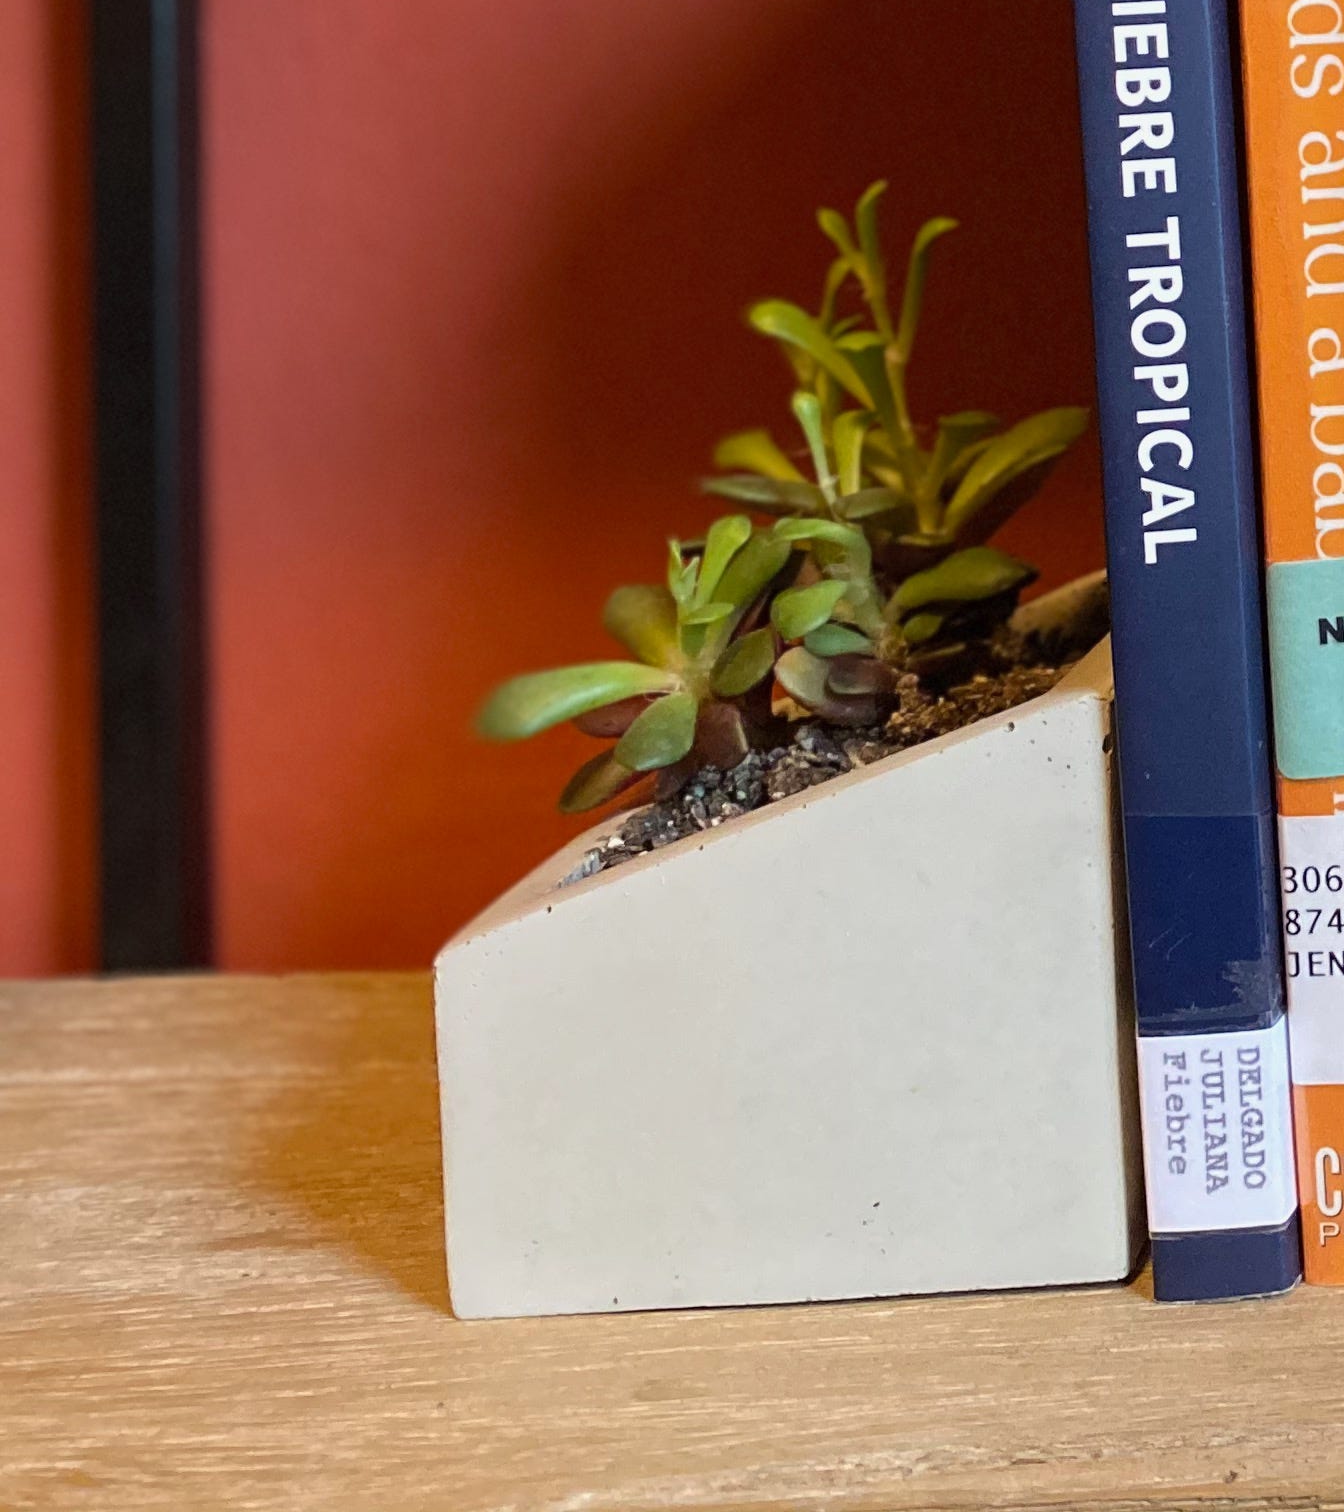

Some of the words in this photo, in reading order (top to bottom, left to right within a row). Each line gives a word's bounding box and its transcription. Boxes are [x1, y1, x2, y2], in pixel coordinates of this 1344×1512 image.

[1125, 216, 1198, 564] TROPICAL
[1163, 1051, 1191, 1176] Fiebre
[1200, 1048, 1230, 1196] JULIANA
[1237, 1045, 1268, 1191] DELGADO
